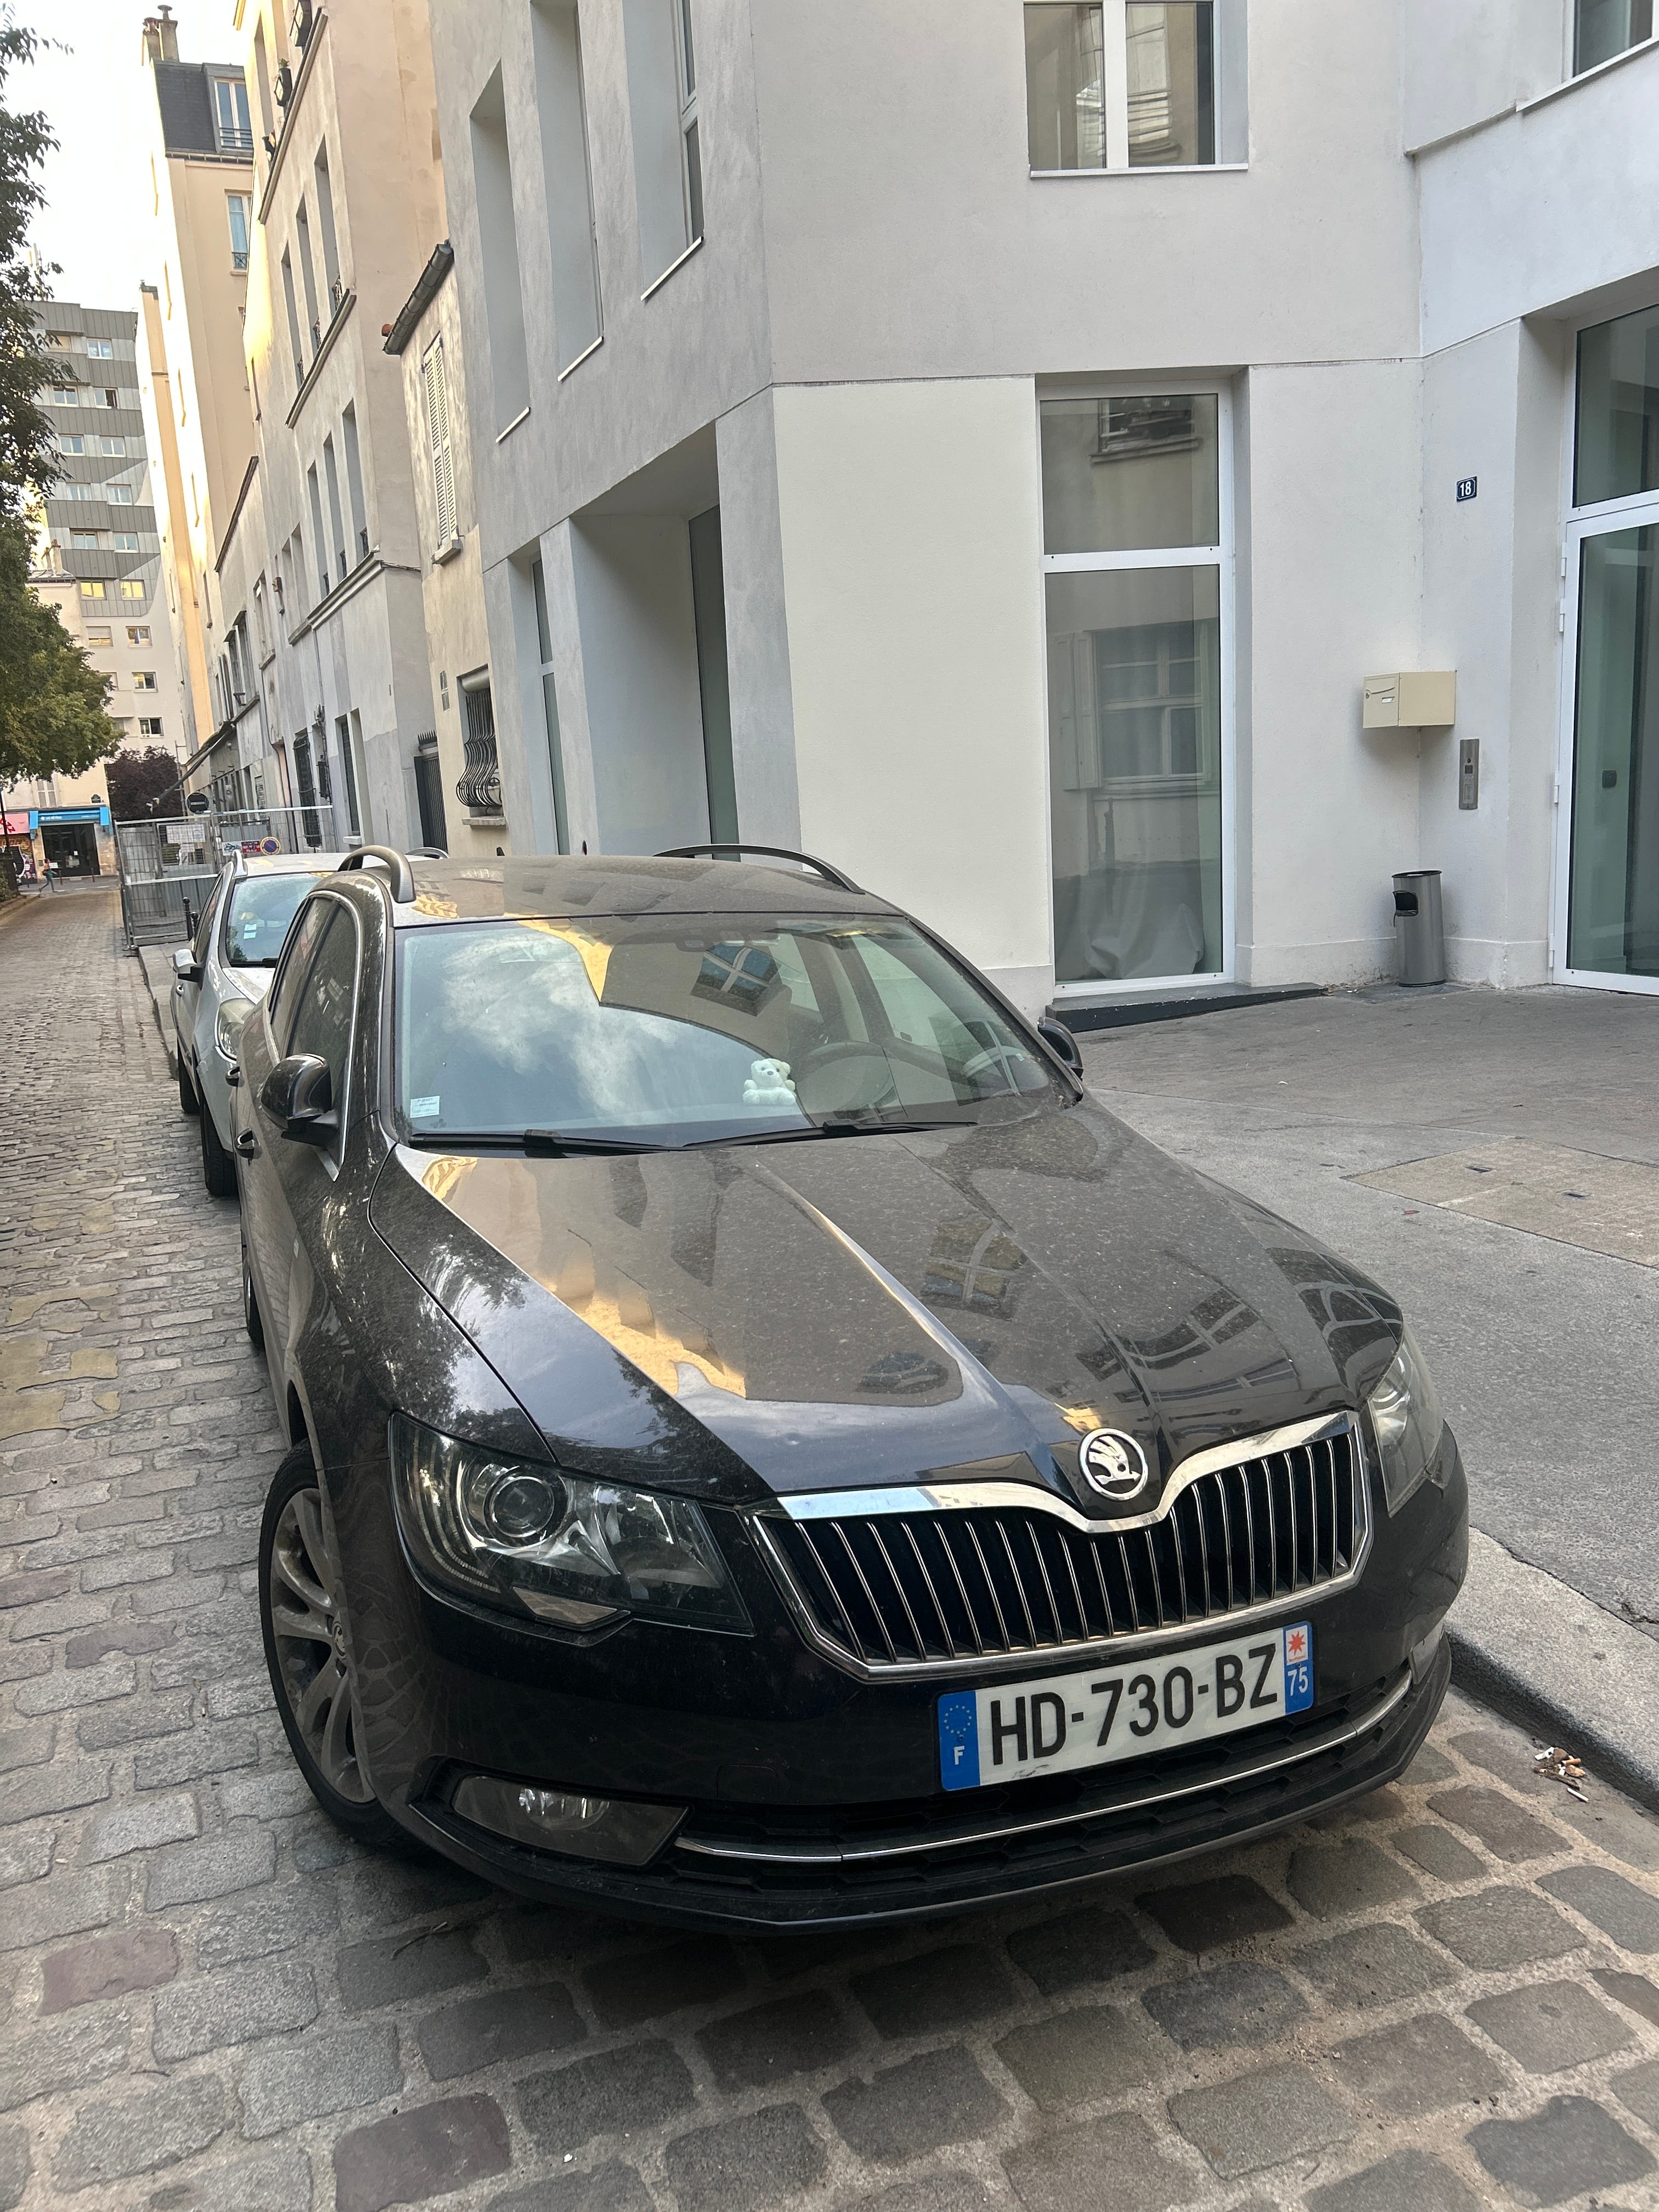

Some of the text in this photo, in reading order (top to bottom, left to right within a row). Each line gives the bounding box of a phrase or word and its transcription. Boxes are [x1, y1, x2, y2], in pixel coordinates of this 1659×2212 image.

[1460, 481, 1471, 496] 18
[1287, 1666, 1308, 1697] 75
[991, 1643, 1277, 1765] HD-730-BZ
[953, 1746, 965, 1765] F
